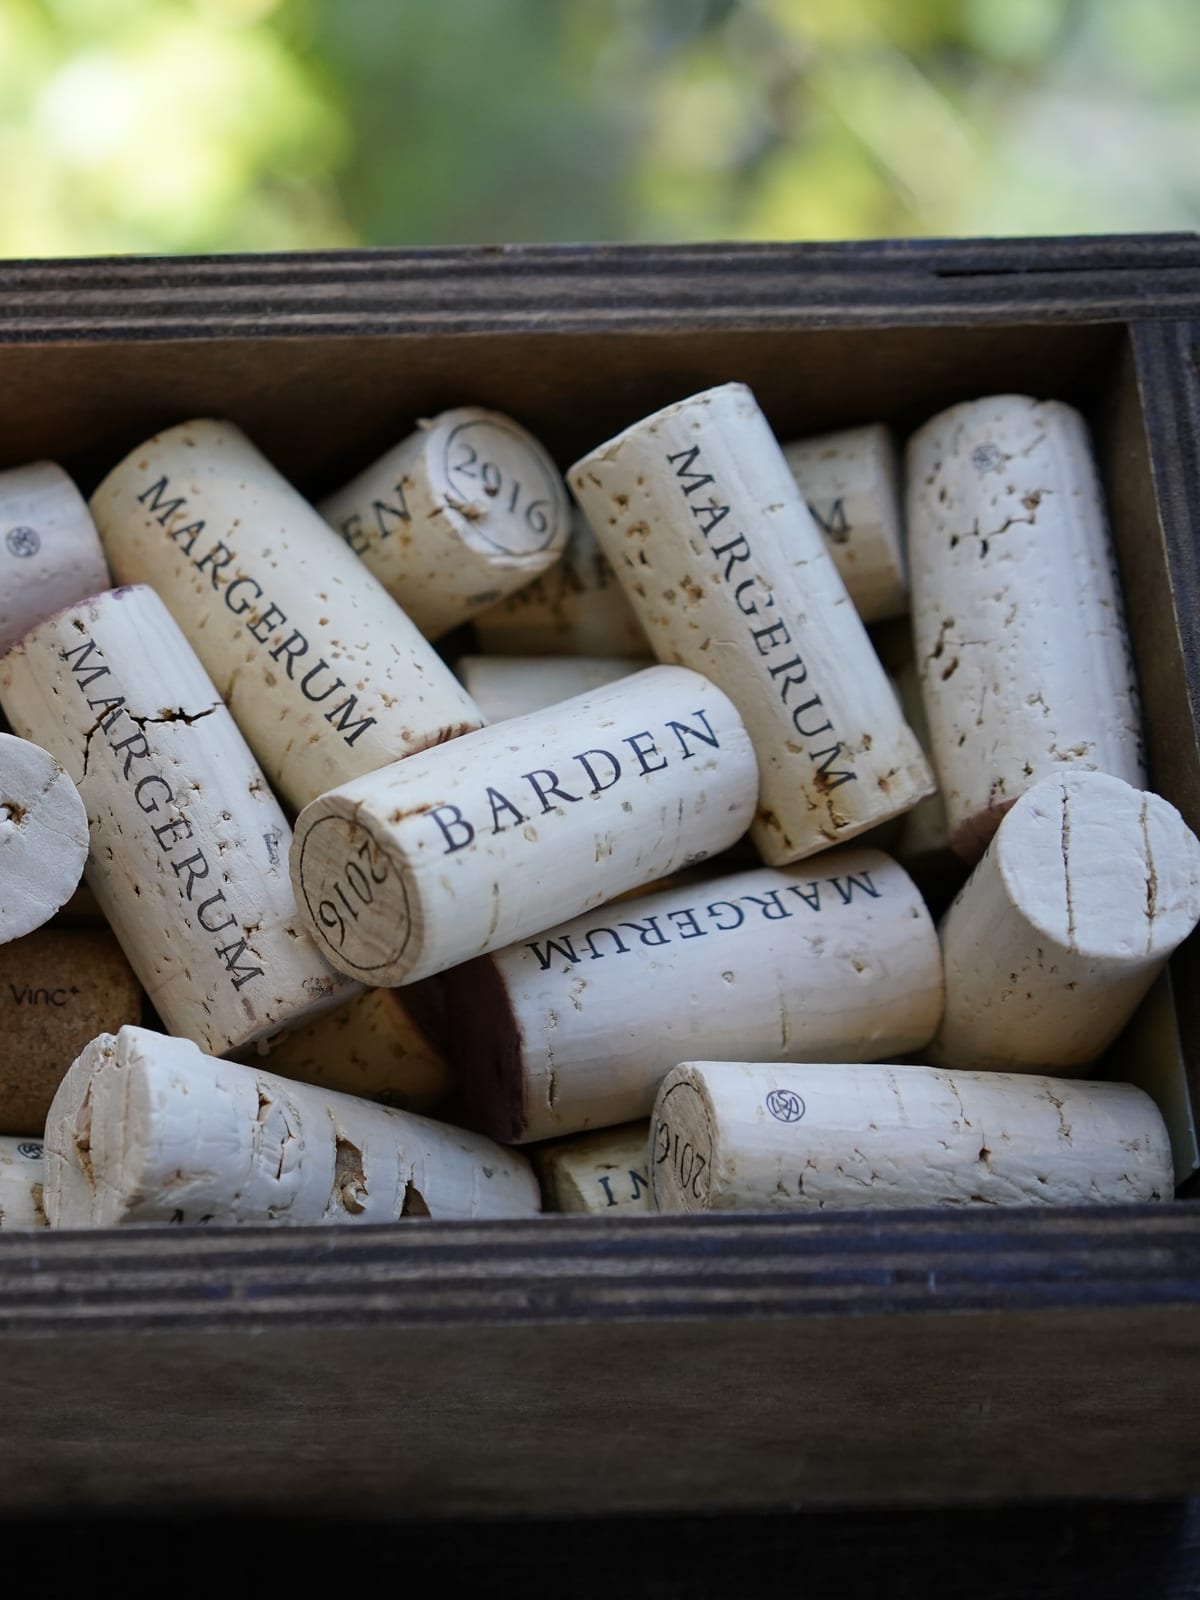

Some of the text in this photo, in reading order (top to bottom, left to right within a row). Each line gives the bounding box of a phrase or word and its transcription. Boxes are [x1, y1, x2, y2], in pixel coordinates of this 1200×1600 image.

[451, 443, 551, 535] 2016
[136, 475, 379, 748] MARGERUM
[666, 445, 858, 795] MARGERUM
[64, 638, 265, 992] MARGERUM
[424, 709, 721, 855] BARDEN
[318, 843, 390, 948] 2016
[525, 870, 883, 971] MARGERUM
